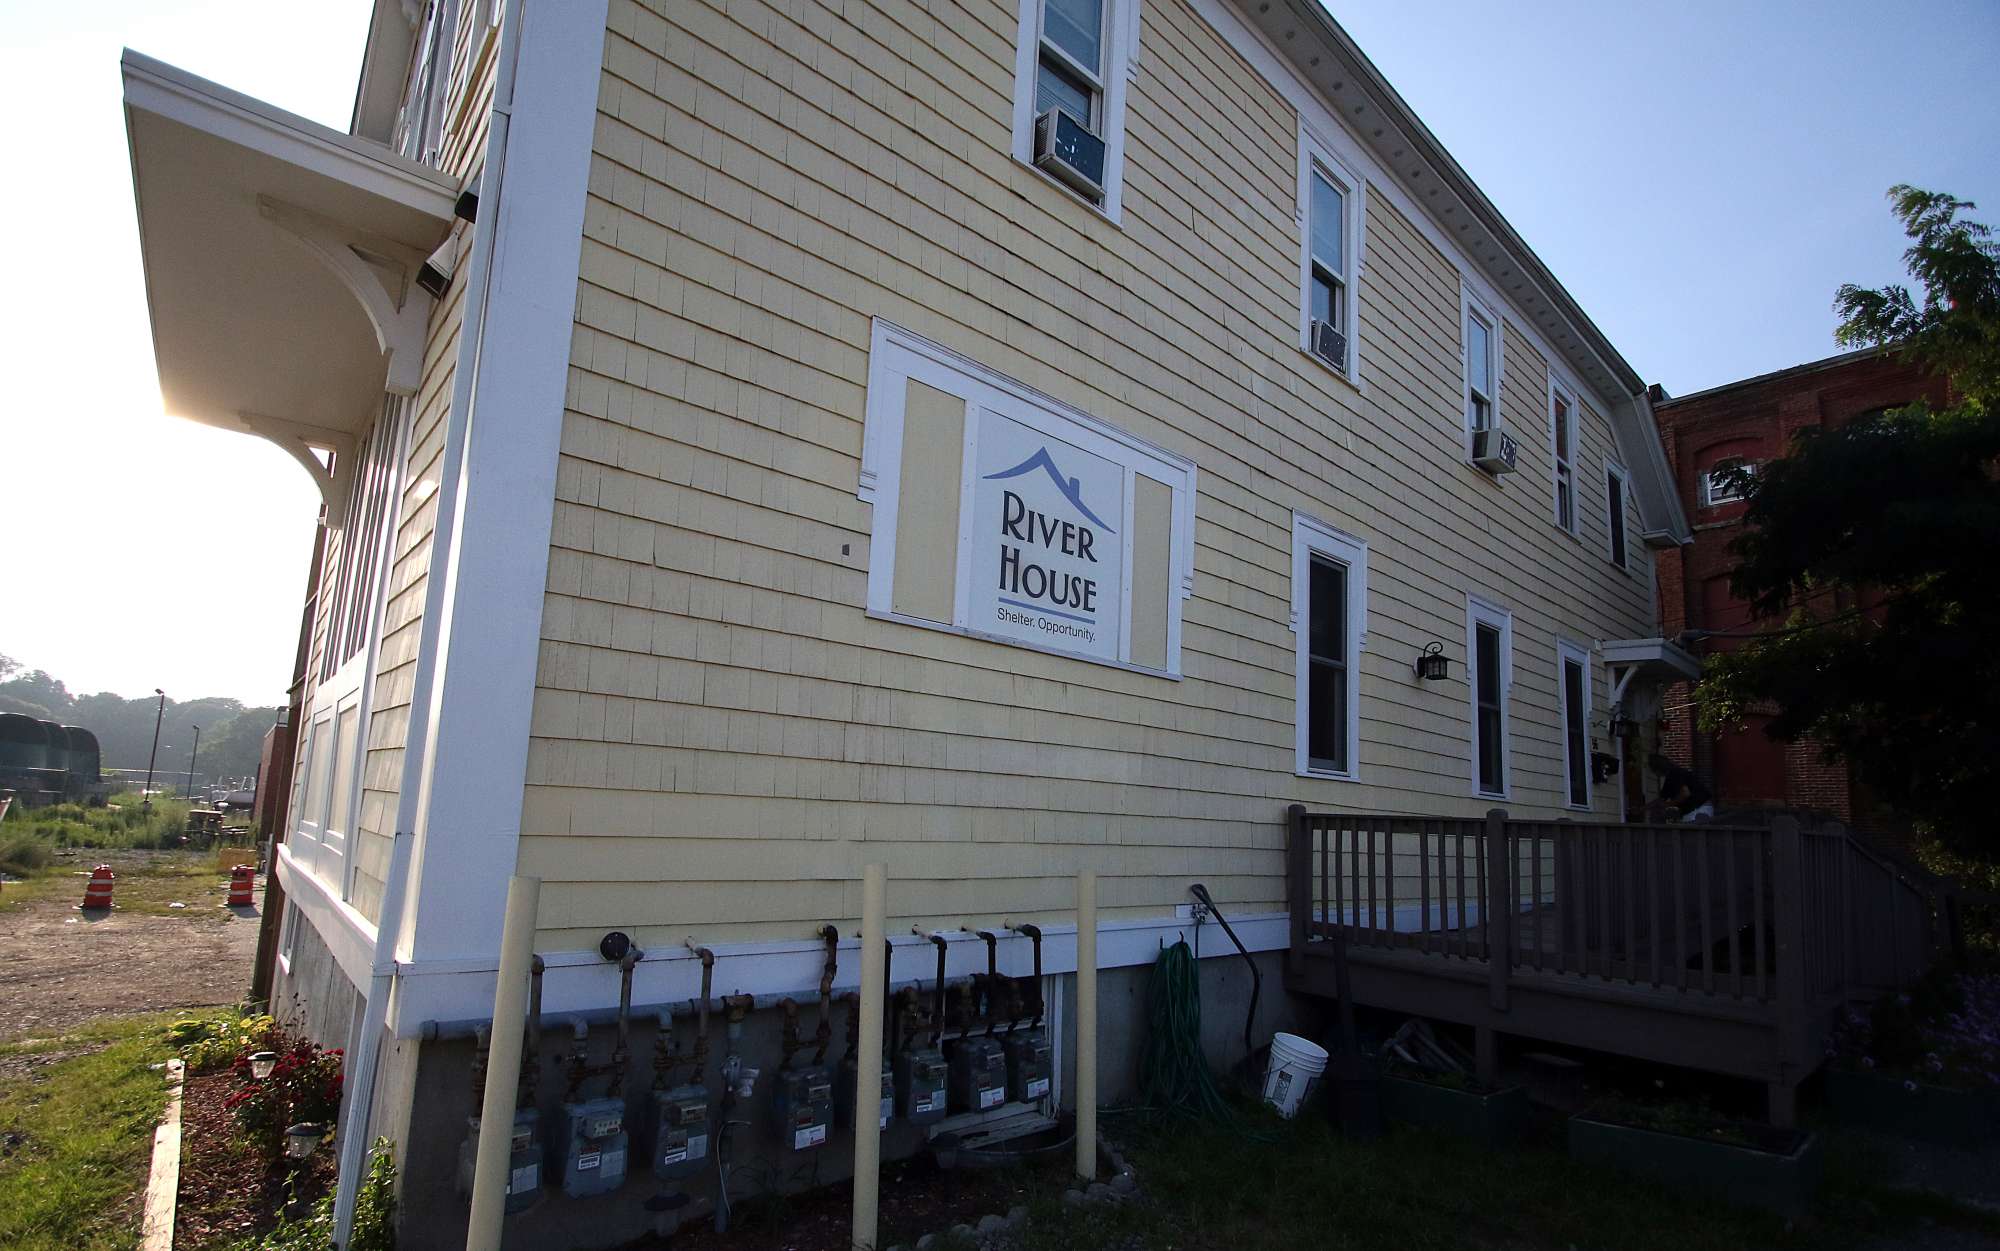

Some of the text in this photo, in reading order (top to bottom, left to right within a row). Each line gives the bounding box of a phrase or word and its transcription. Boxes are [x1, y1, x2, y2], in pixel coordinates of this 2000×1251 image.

[1001, 490, 1098, 562] RIVER
[999, 544, 1097, 612] HOUSE
[997, 607, 1096, 643] Shelter. Opportunity.
